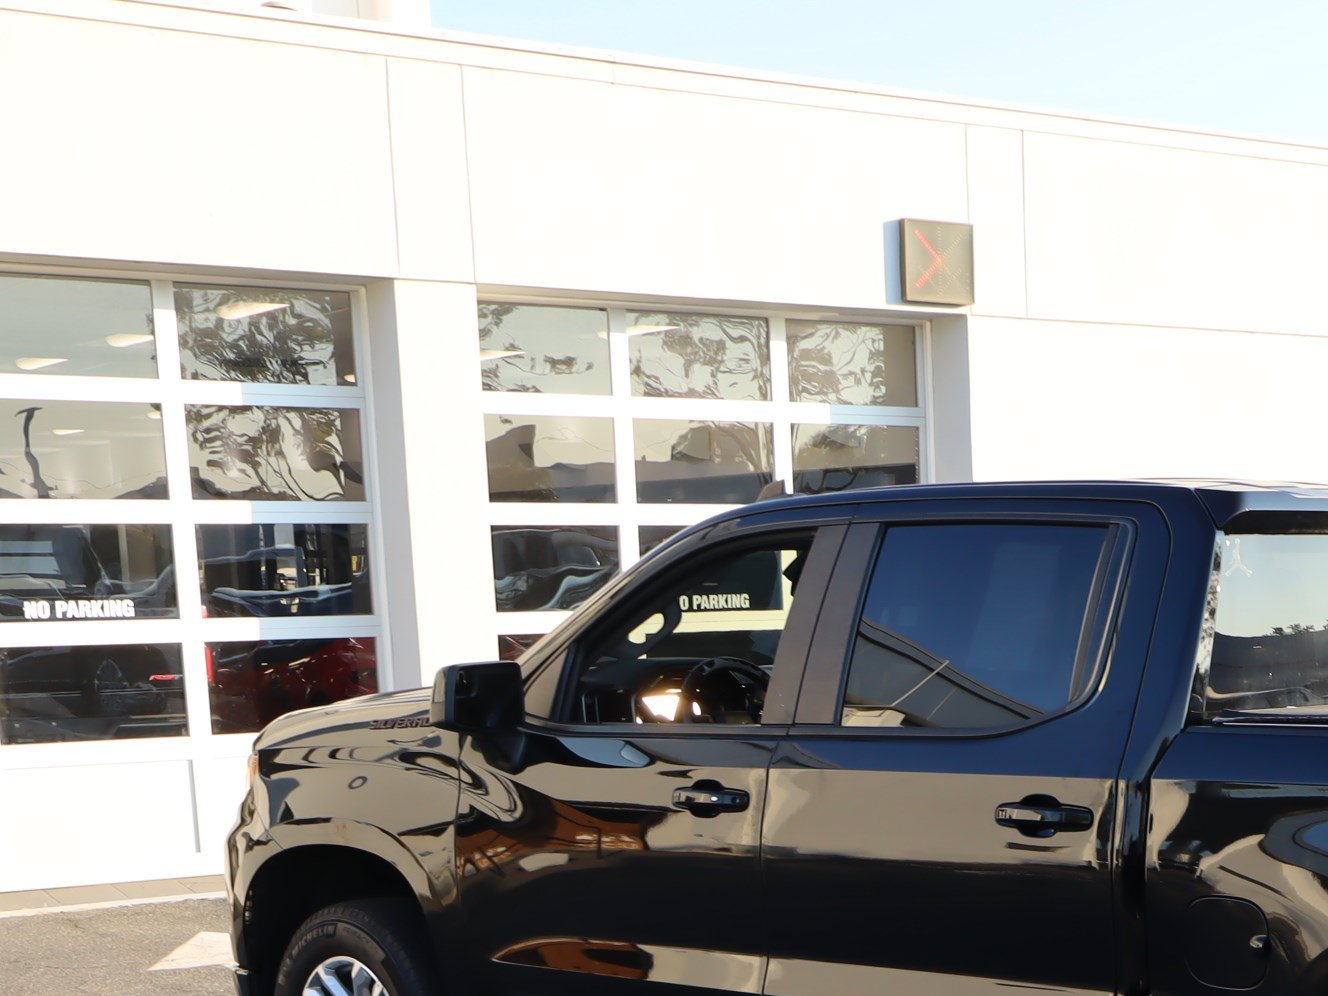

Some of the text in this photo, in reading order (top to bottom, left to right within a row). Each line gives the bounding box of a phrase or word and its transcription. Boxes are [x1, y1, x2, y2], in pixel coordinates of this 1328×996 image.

[23, 599, 135, 619] NO PARKING
[679, 593, 750, 610] O PARKING
[368, 717, 432, 729] SILVERAD
